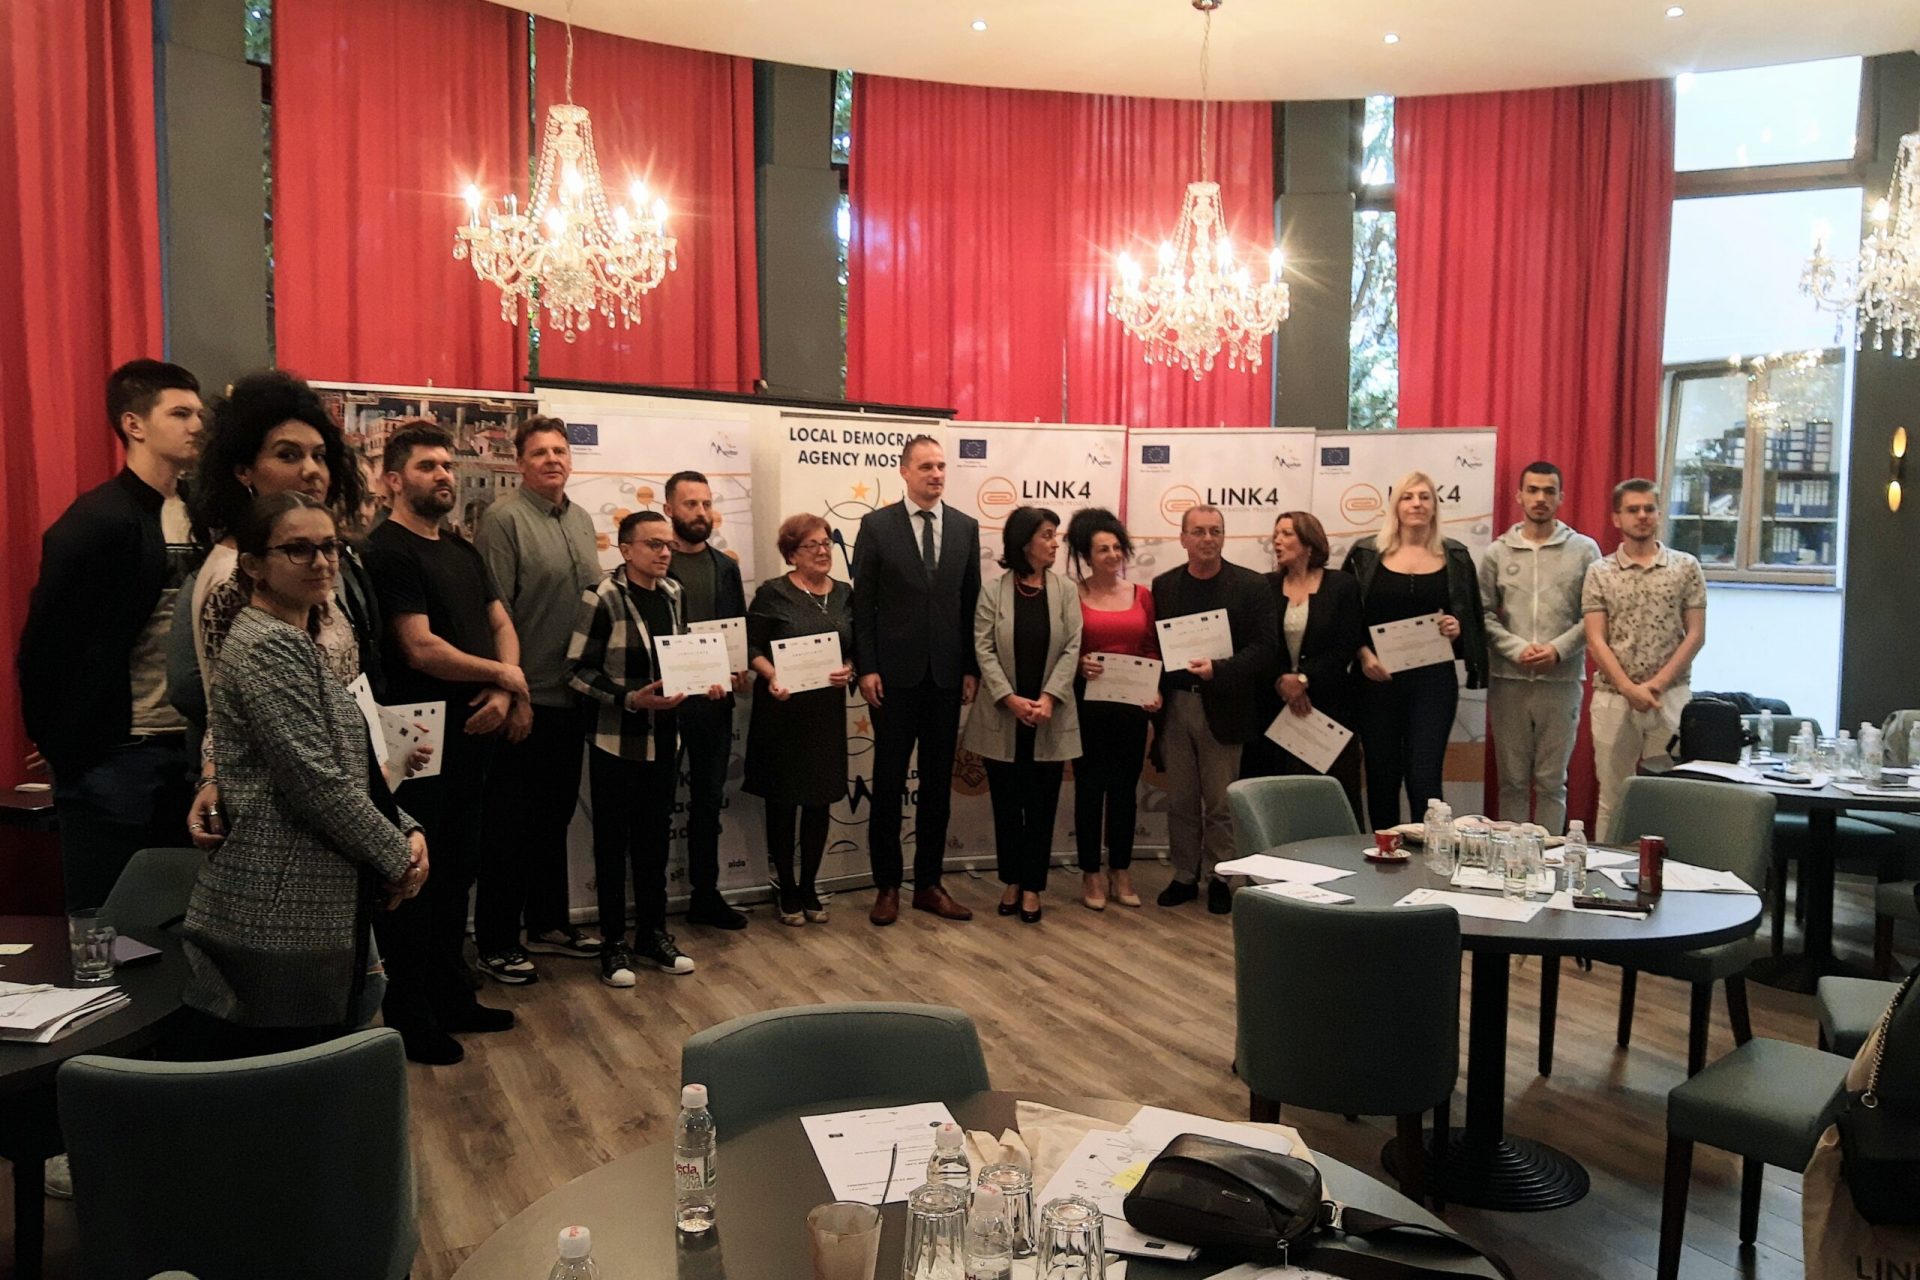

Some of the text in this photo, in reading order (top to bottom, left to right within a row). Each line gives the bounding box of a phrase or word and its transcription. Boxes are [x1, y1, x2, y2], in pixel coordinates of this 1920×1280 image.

[790, 427, 837, 443] LOCAL
[797, 449, 904, 468] AGENCY MOST
